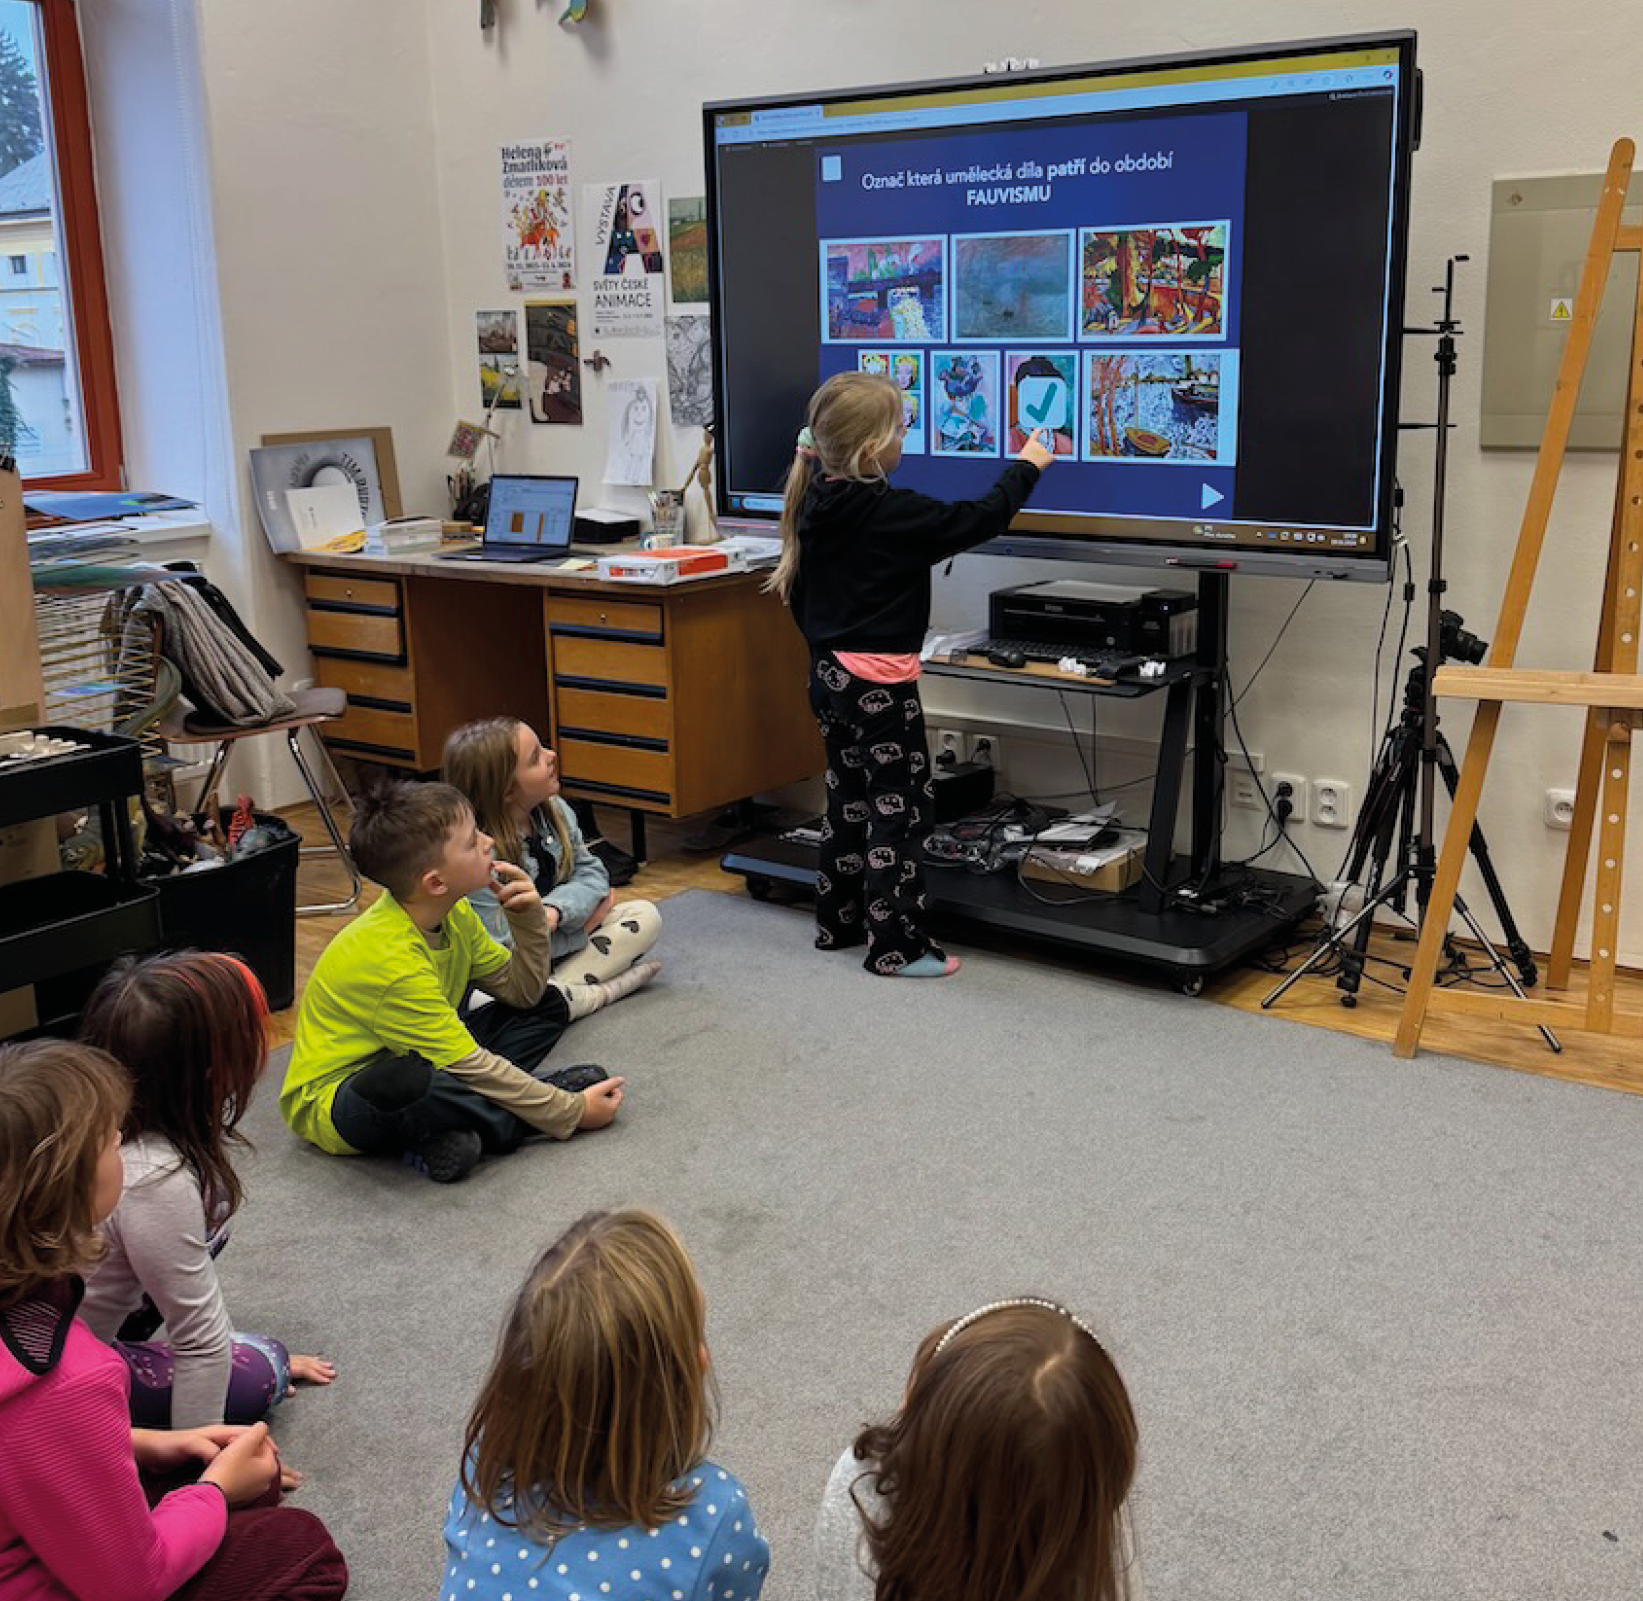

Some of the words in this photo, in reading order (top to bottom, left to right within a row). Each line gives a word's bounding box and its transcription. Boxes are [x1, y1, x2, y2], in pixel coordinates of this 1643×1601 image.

[502, 145, 542, 159] Helena
[861, 172, 904, 190] Označ
[906, 168, 943, 188] která
[945, 162, 1013, 184] umělecká
[1016, 160, 1044, 180] díla
[1047, 157, 1086, 181] patří
[1089, 155, 1110, 175] do
[1114, 151, 1174, 173] období
[966, 184, 1051, 206] FAUVISMU
[594, 292, 653, 308] ANIMACE
